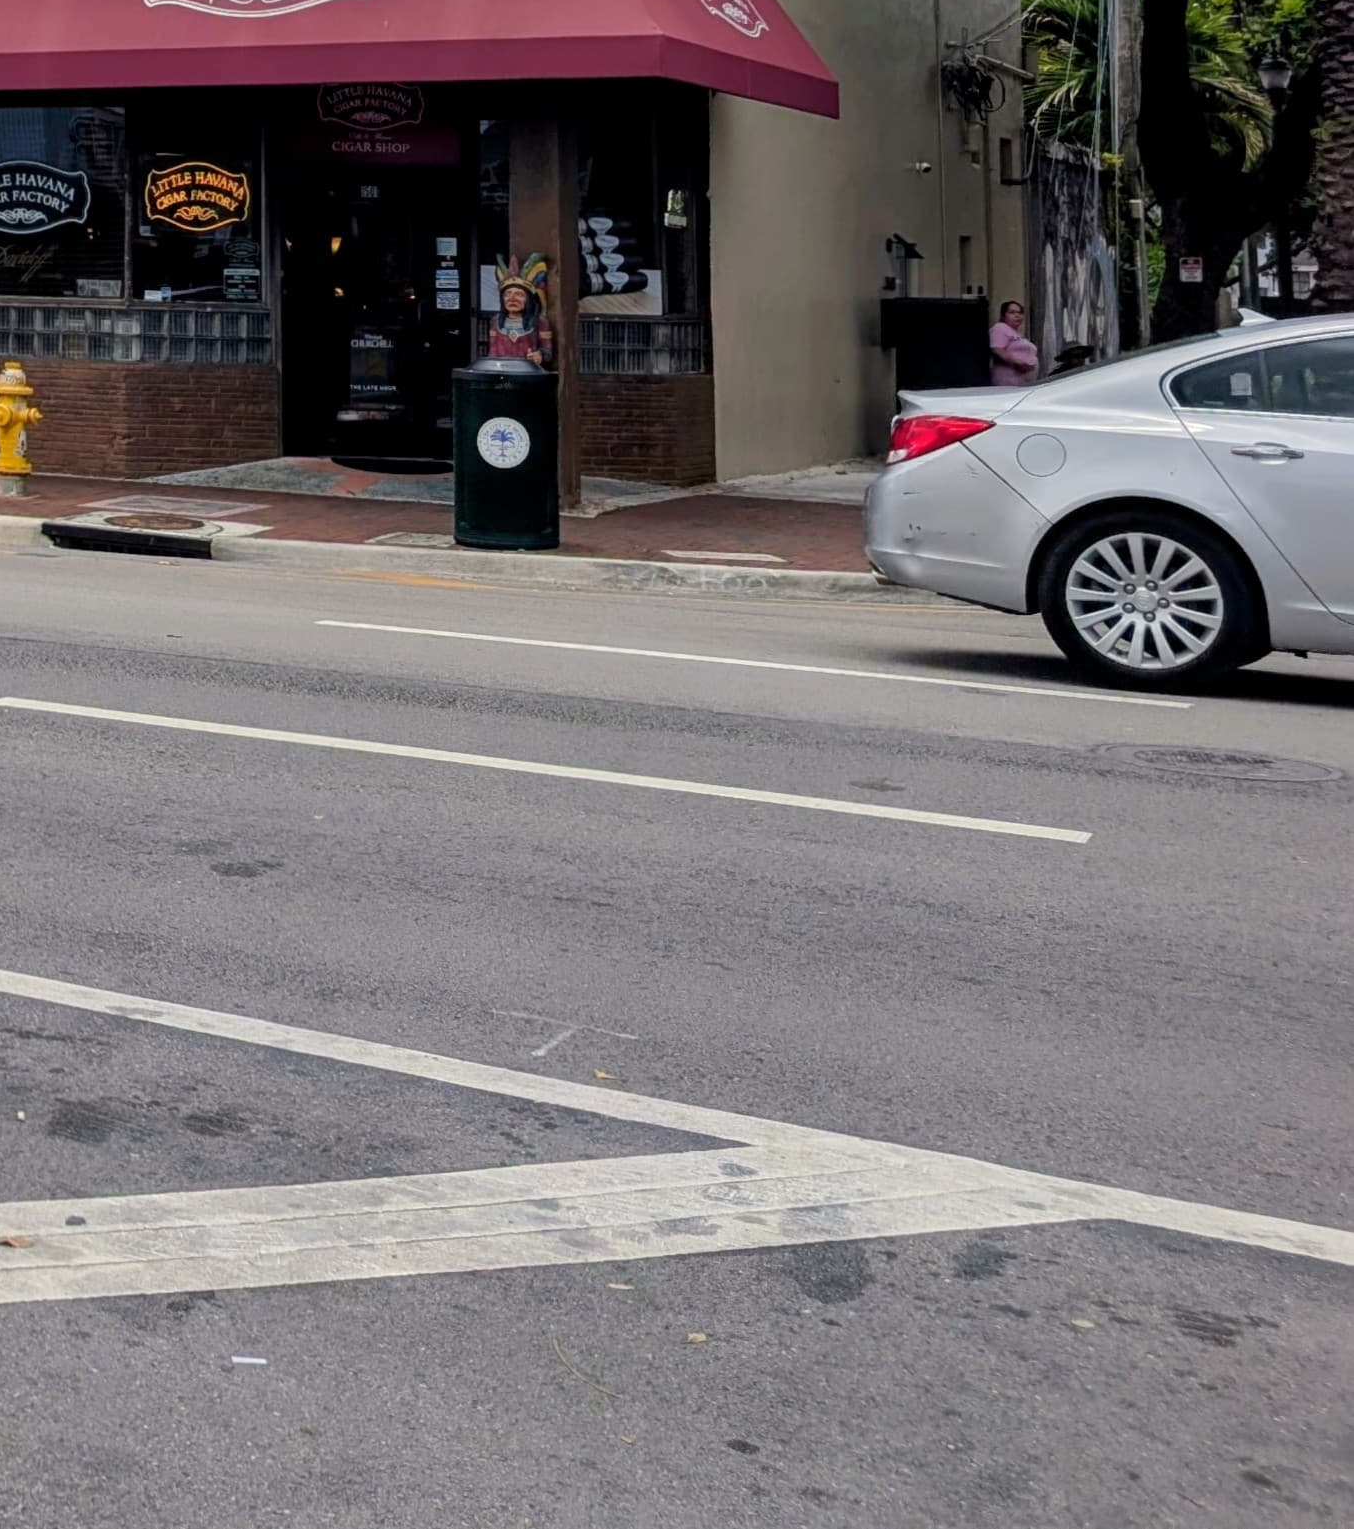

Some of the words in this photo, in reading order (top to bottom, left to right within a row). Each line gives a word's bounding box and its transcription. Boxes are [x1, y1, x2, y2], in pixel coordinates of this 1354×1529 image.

[326, 85, 364, 105] LITTLE
[366, 85, 413, 107] HAVANA
[331, 140, 373, 153] CIGAR
[374, 142, 411, 153] SHOP
[15, 172, 75, 202] HAVANA
[151, 171, 192, 197] LITTLE
[194, 171, 245, 201] HAVANA
[12, 189, 70, 214] FACTORY
[156, 190, 189, 210] CIGAR
[190, 189, 240, 212] FACTORY
